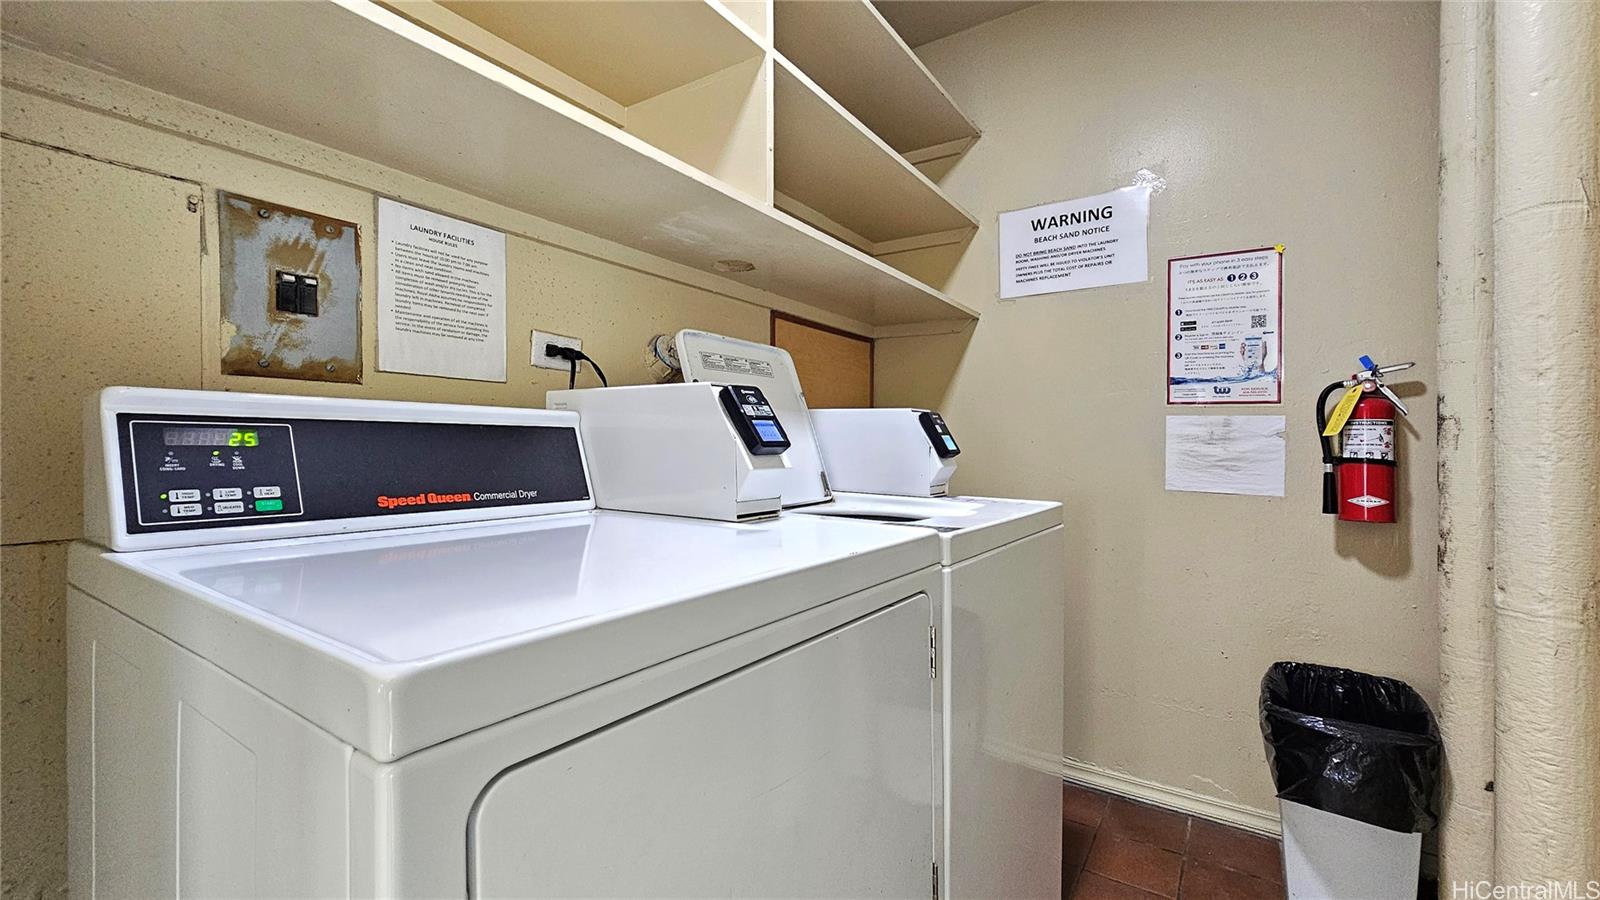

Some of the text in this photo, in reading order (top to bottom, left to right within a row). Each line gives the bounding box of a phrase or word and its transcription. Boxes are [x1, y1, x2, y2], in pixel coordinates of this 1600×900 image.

[1031, 206, 1112, 232] WARNING
[410, 224, 475, 246] LAUNDRY FACILITIES
[1034, 225, 1110, 243] BEACH SAND NOTICE
[1039, 272, 1071, 280] REPLACEMENT
[229, 432, 256, 447] 25
[377, 490, 538, 508] Speed Queen Commercial Dryer
